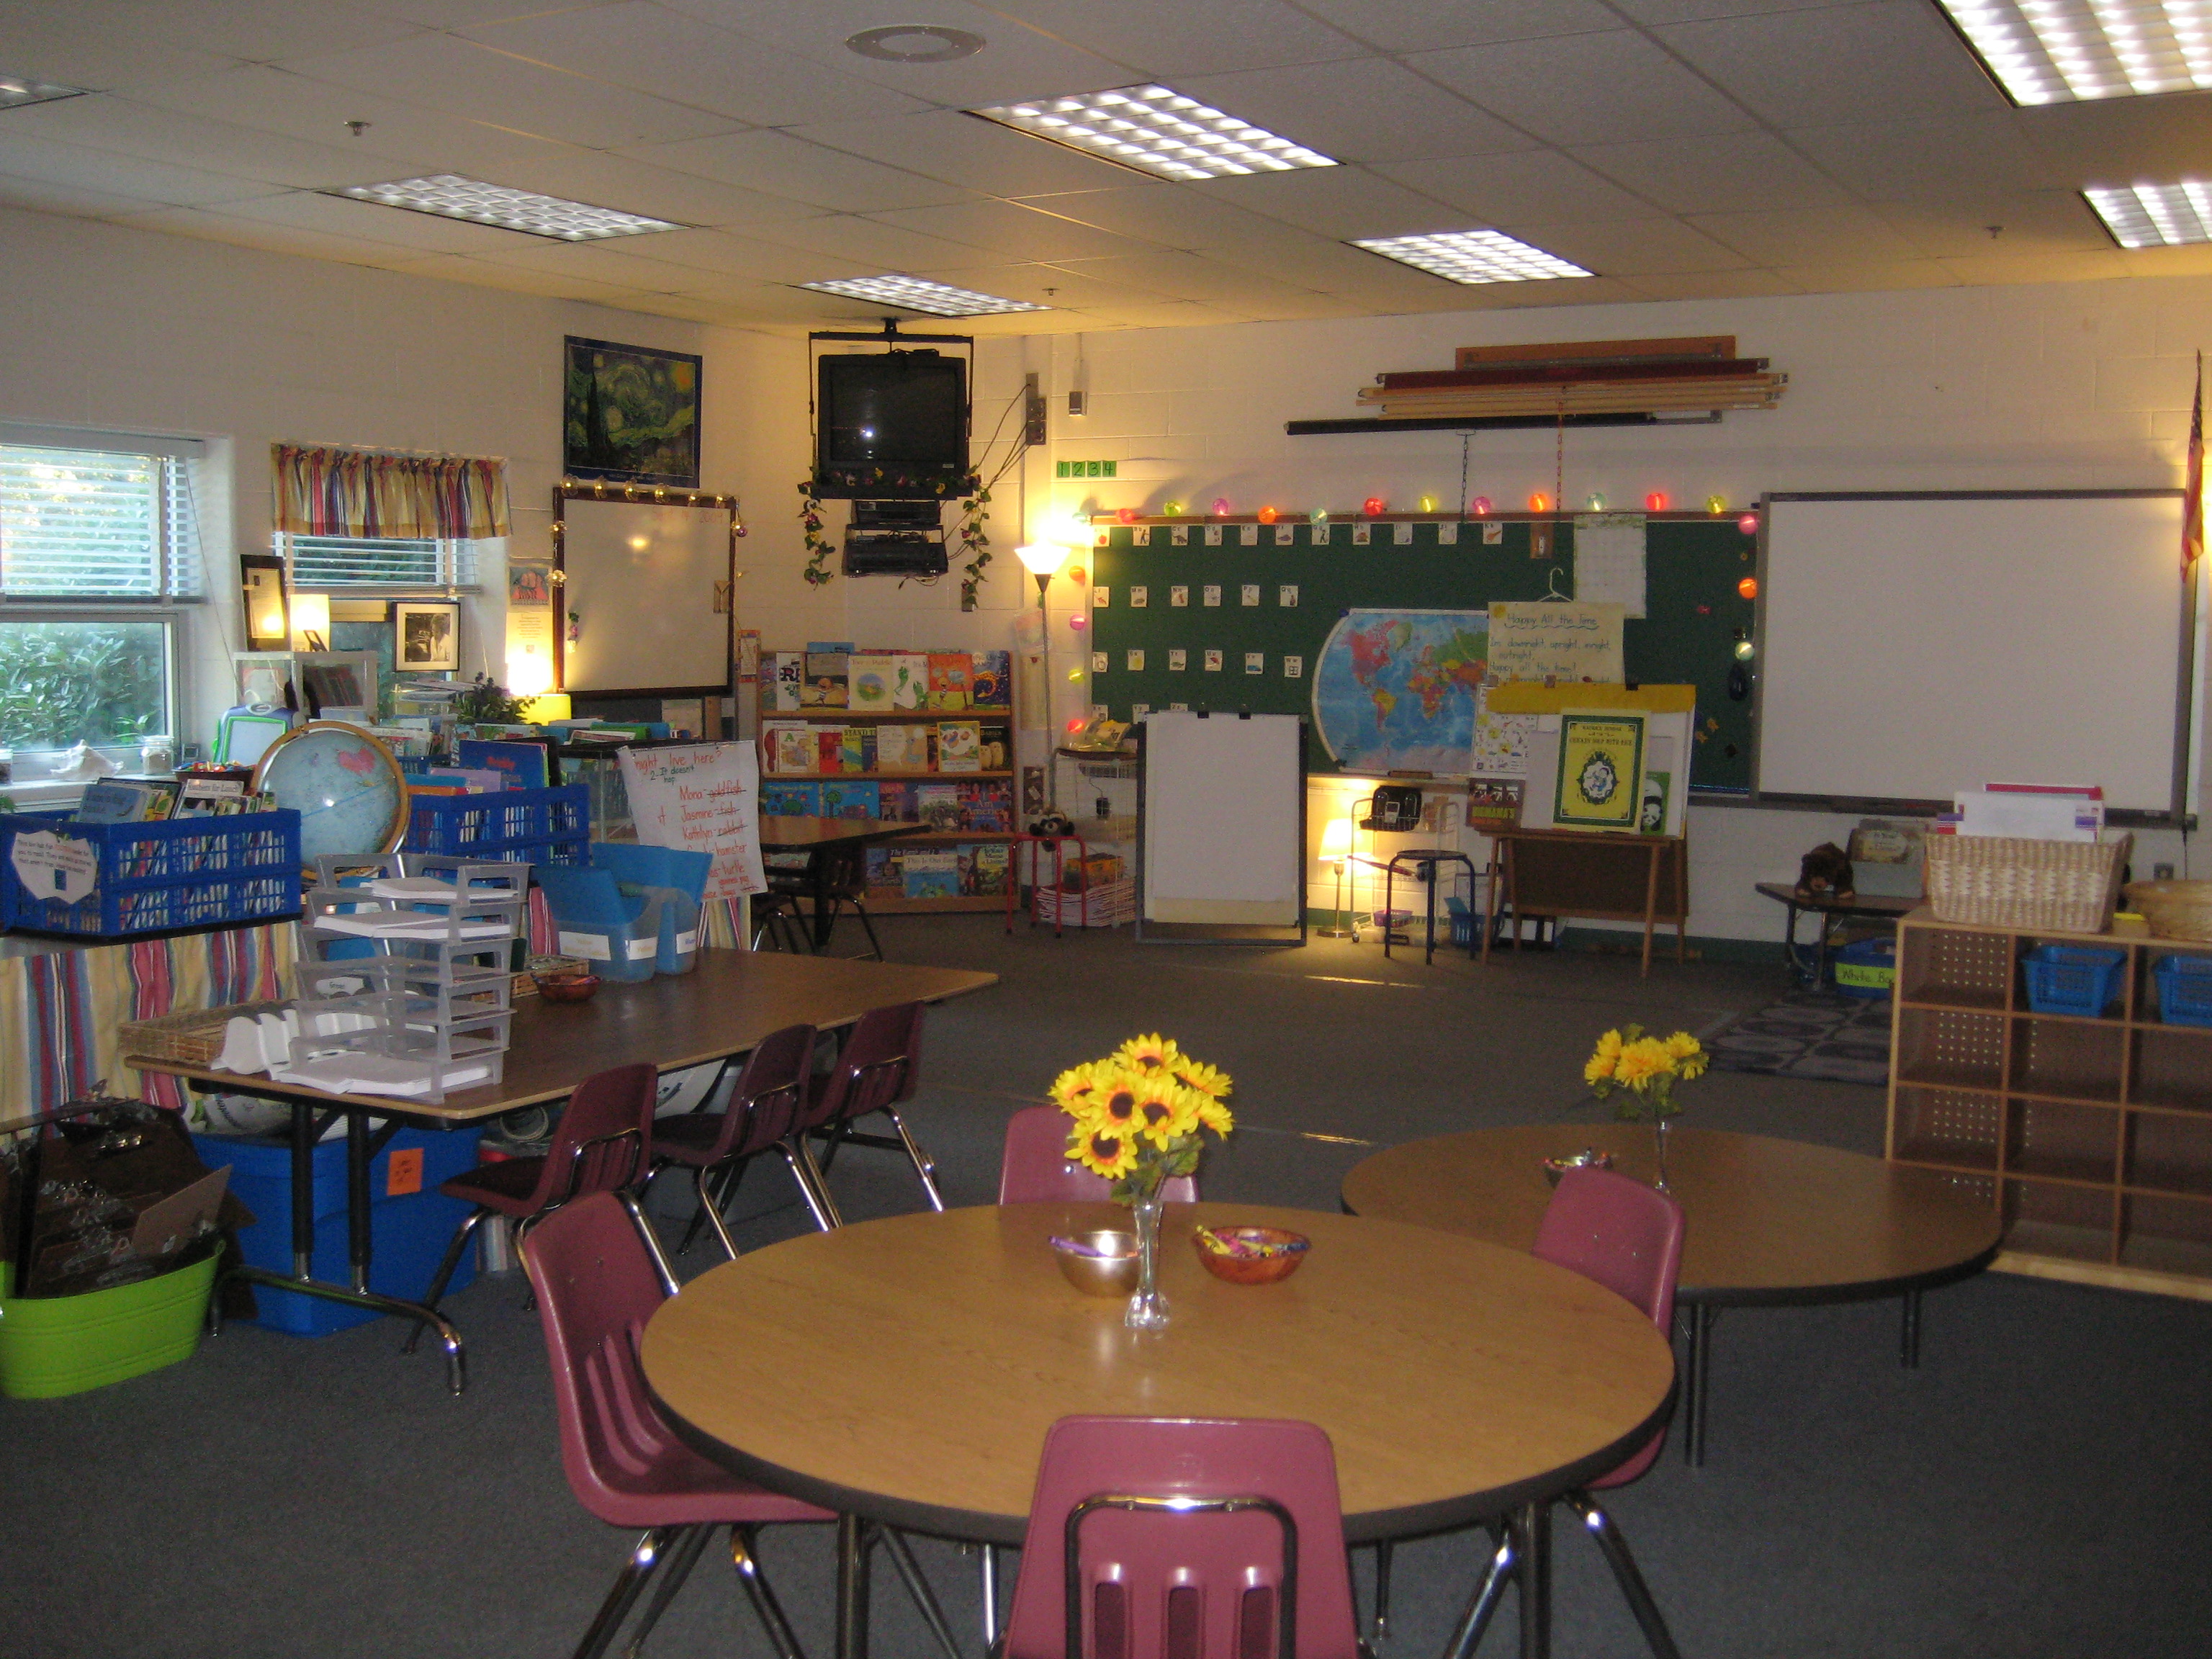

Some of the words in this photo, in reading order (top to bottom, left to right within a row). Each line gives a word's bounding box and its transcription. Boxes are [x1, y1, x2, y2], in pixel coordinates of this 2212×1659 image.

[1073, 462, 1082, 476] 2
[1088, 462, 1099, 476] 3
[1105, 462, 1113, 475] 4
[1508, 613, 1537, 624] Happy
[1541, 613, 1553, 624] All
[1560, 613, 1573, 624] the
[1578, 613, 1597, 624] Time
[1537, 662, 1549, 671] the
[669, 752, 687, 766] live
